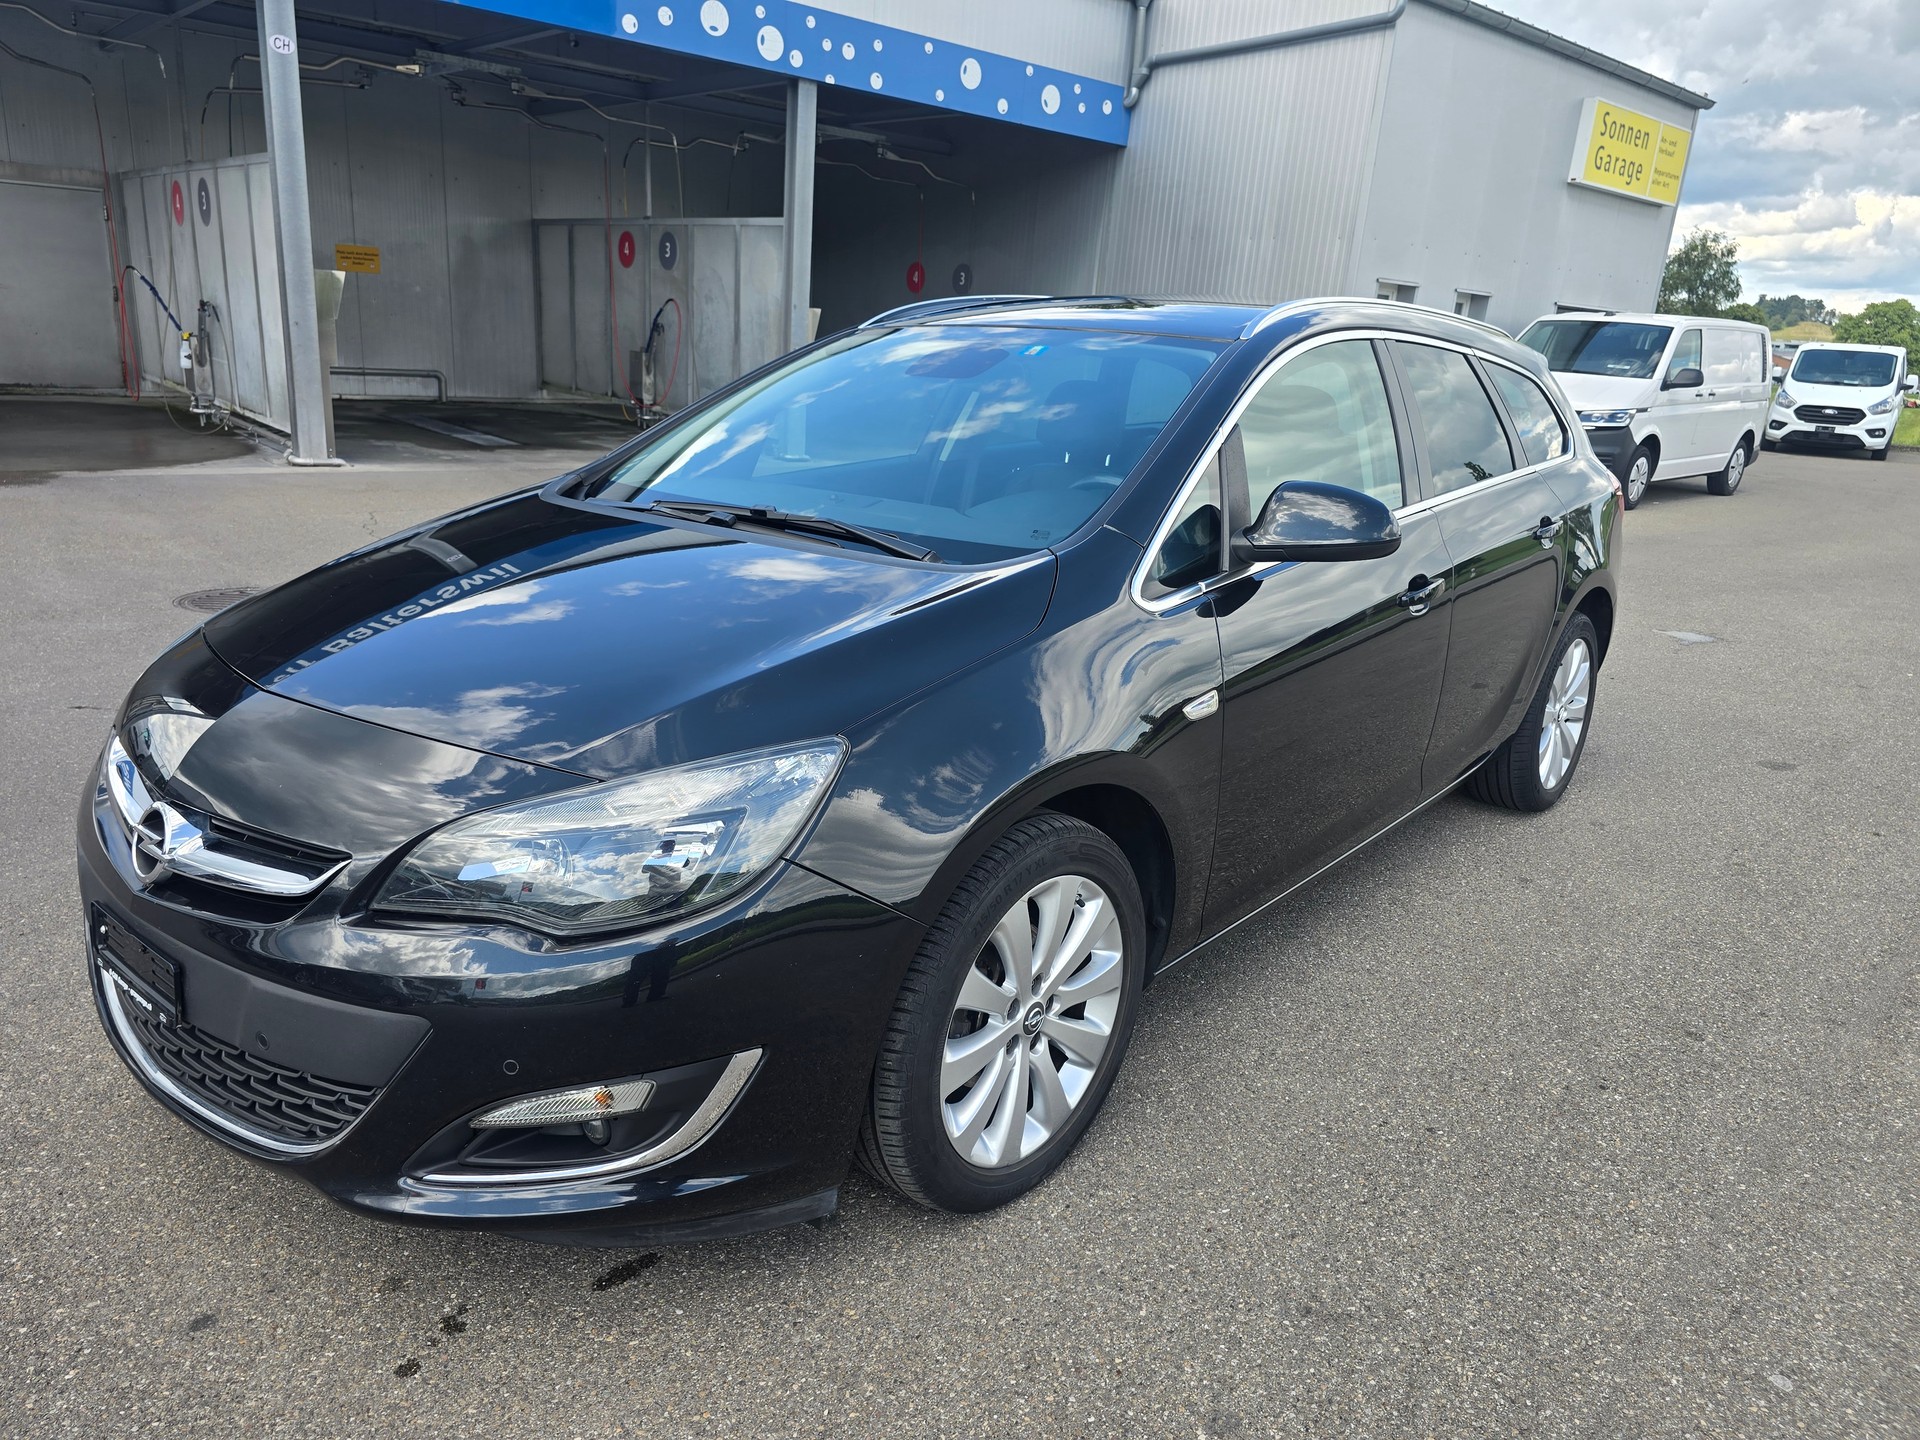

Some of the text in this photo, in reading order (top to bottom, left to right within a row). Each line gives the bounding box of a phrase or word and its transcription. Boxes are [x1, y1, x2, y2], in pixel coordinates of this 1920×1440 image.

[274, 37, 290, 52] CH
[1600, 111, 1650, 150] Sonnen
[1594, 145, 1643, 186] Garage
[201, 191, 207, 210] 3
[624, 241, 630, 257] 4
[664, 242, 671, 258] 3
[912, 270, 919, 284] 4
[959, 272, 966, 286] 3
